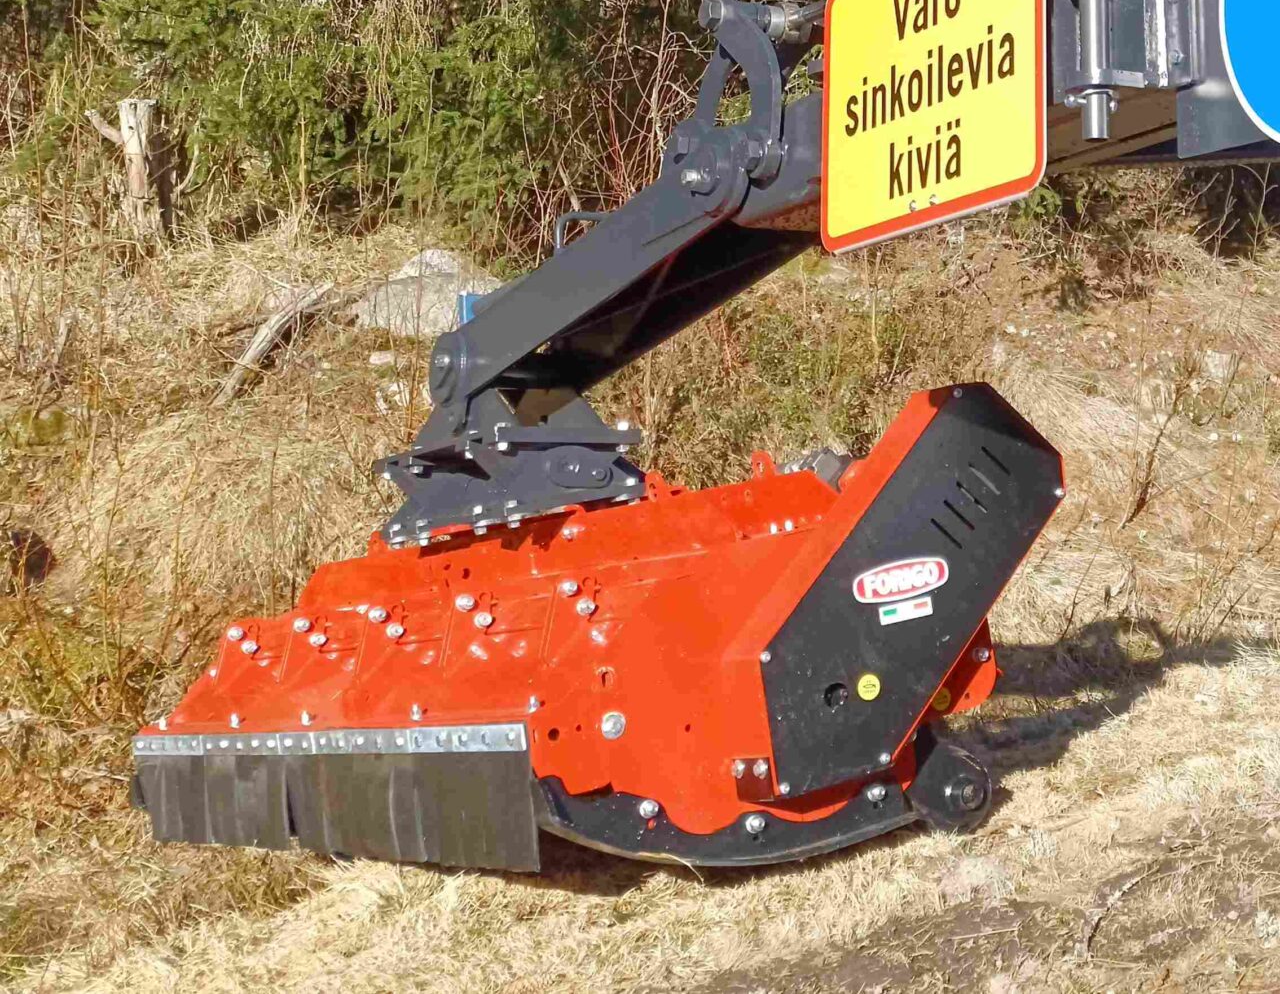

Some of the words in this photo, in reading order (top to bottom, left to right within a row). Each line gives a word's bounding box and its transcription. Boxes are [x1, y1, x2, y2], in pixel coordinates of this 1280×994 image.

[844, 24, 1015, 137] sinkoilevia
[888, 118, 962, 200] kiviä
[862, 561, 940, 599] FORIGO
